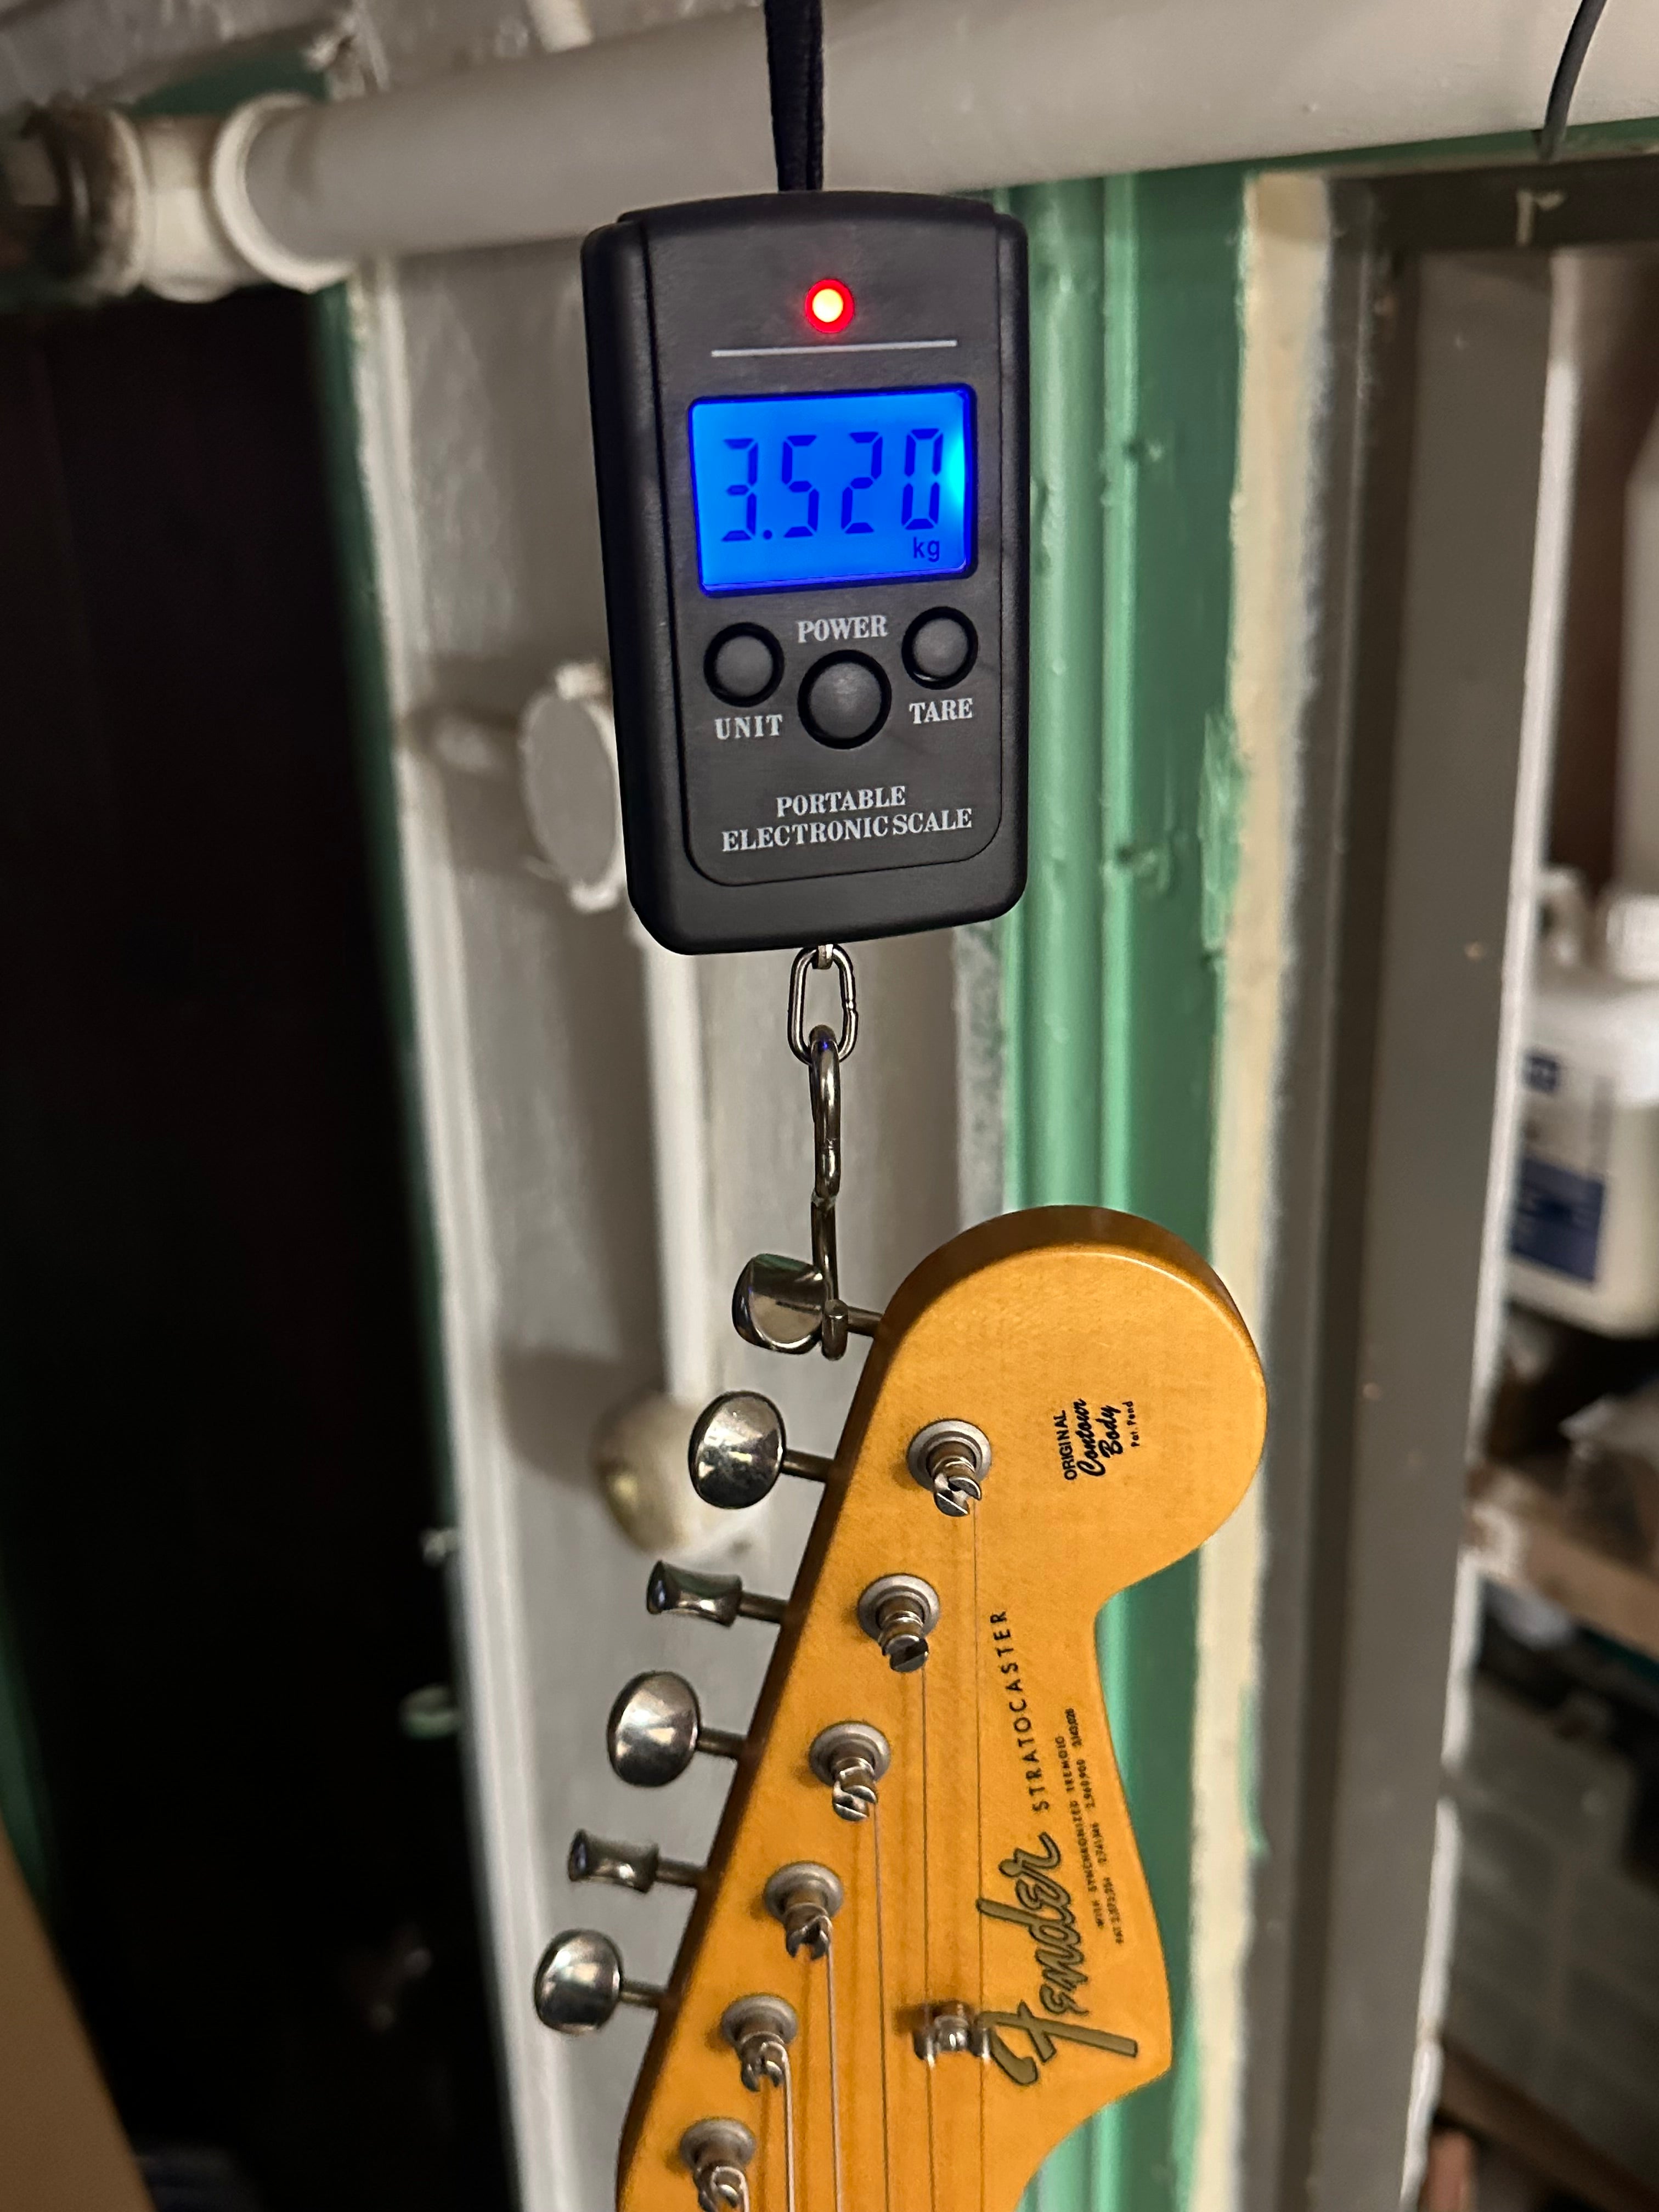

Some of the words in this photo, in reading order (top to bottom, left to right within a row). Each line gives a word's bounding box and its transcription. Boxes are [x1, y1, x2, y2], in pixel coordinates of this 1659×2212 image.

[720, 428, 944, 542] 3.520
[913, 537, 940, 562] kg
[797, 615, 888, 643] POWER
[715, 714, 783, 740] UNIT
[909, 698, 973, 724] TARE
[776, 786, 906, 817] PORTABLE
[721, 815, 889, 852] ELECTRONIC
[891, 808, 973, 836] SCALE
[1053, 1409, 1077, 1481] ORIGINAL
[1073, 1398, 1106, 1477] Contour
[1095, 1405, 1123, 1458] Body
[990, 1610, 1050, 1815] STRATOCASTER
[975, 1831, 1138, 2085] Fender
